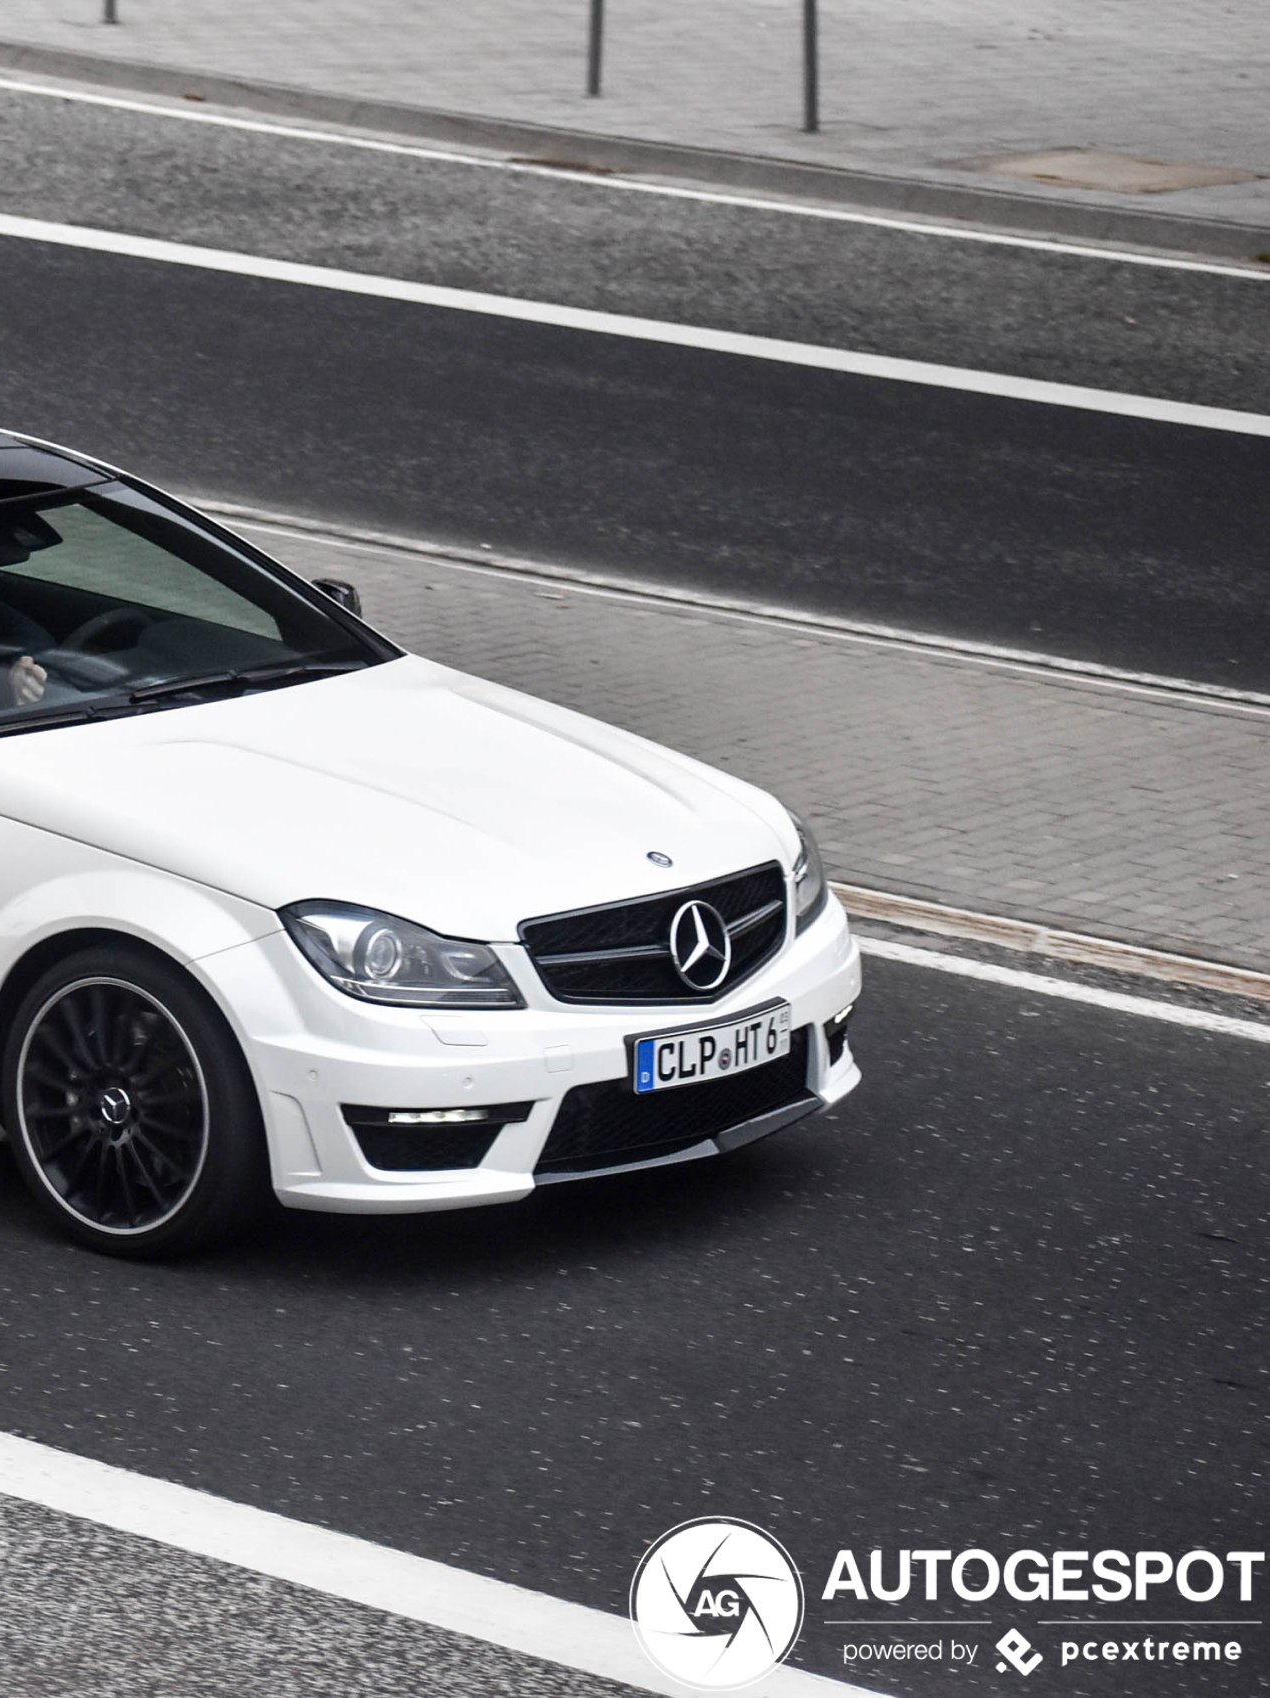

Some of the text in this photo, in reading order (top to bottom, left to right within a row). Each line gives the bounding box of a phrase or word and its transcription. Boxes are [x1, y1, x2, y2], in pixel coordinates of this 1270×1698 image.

[658, 1017, 777, 1081] CLP HT 6
[641, 1071, 650, 1083] D
